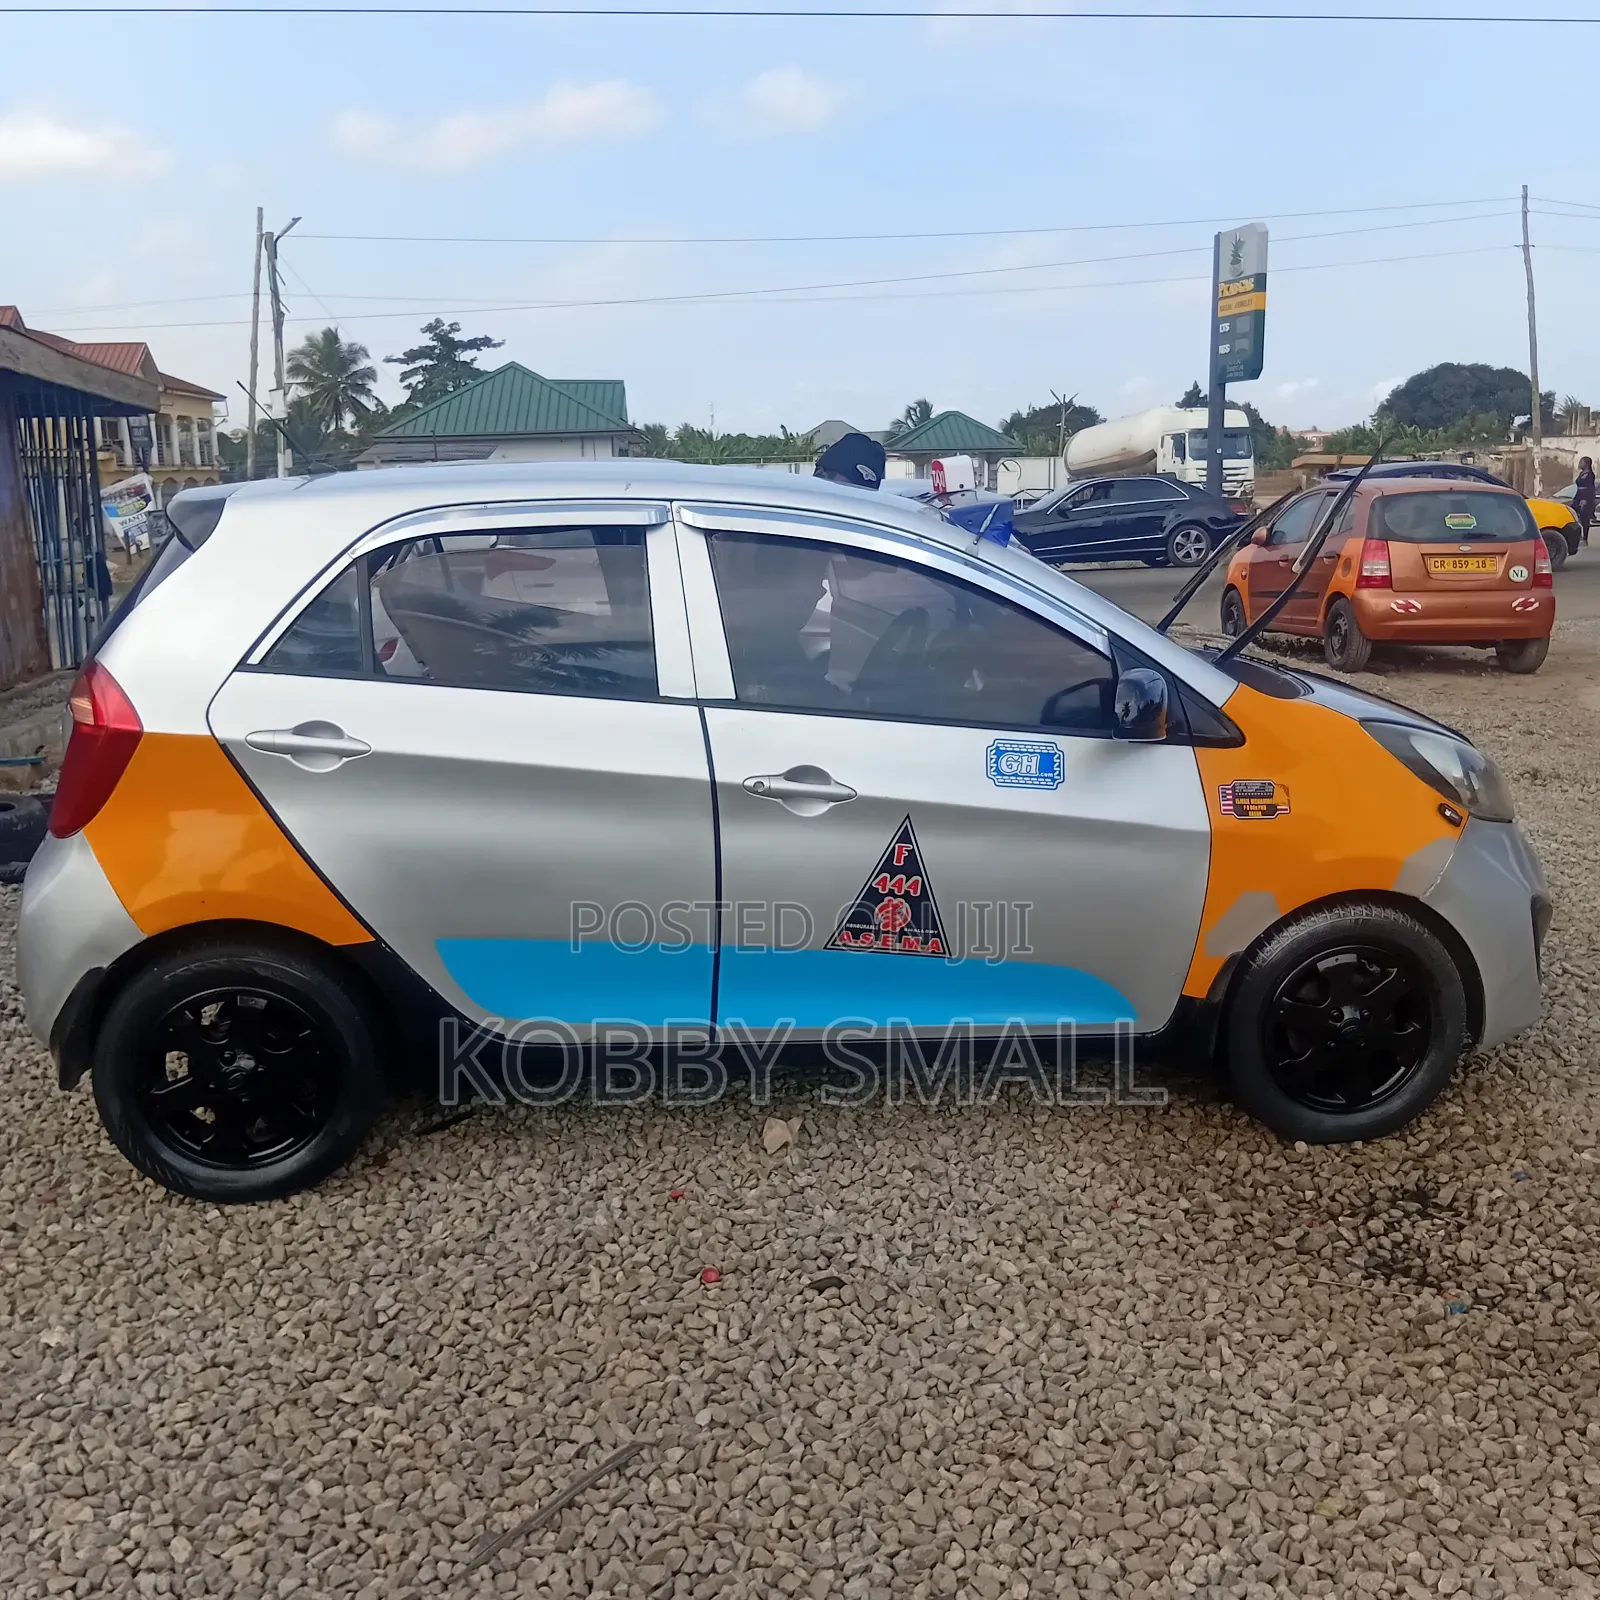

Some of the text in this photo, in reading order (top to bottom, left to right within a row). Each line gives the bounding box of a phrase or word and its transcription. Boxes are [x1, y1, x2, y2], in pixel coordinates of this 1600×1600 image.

[1433, 559, 1446, 569] CR
[1512, 570, 1525, 578] NL
[998, 752, 1040, 776] GH
[893, 843, 913, 865] F
[872, 873, 922, 896] 444
